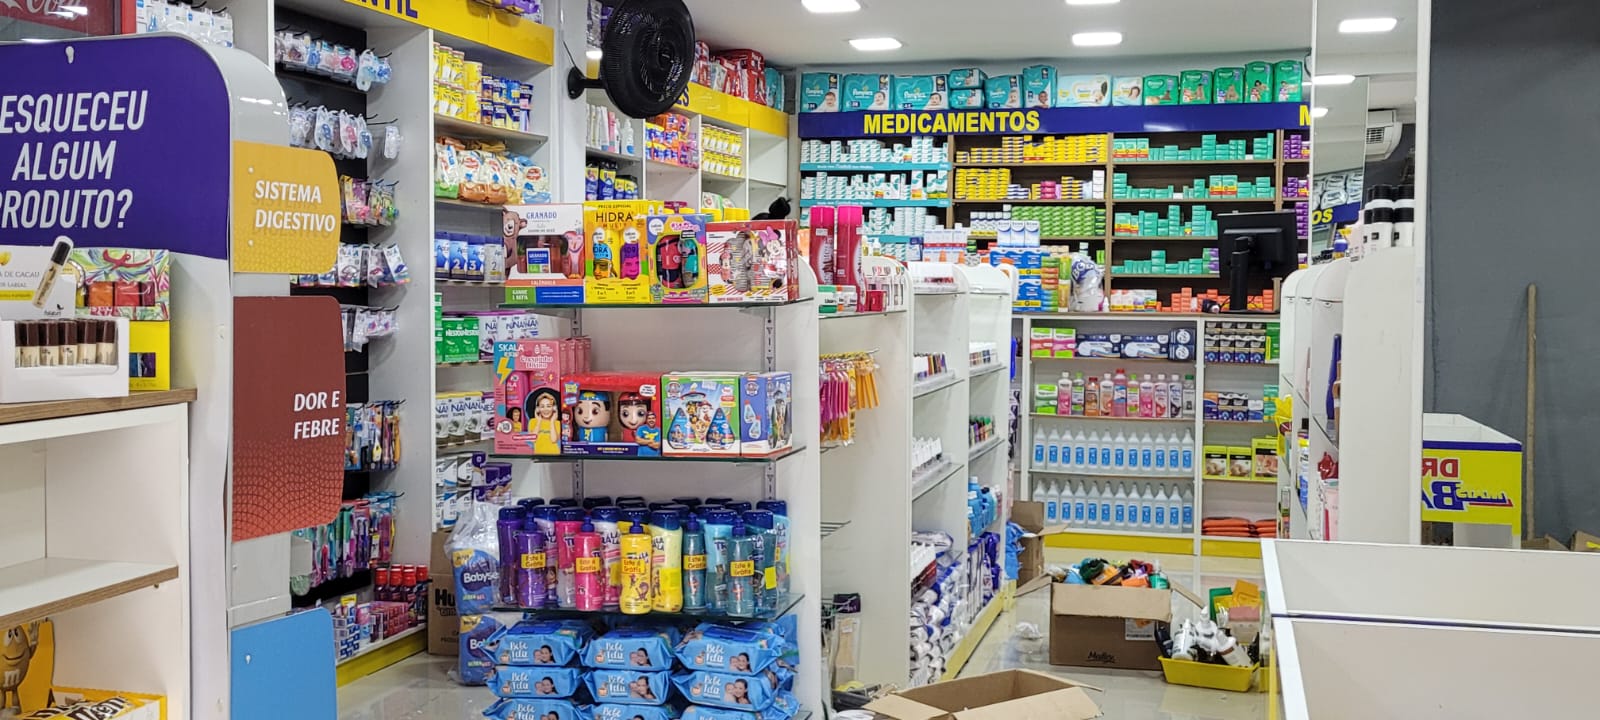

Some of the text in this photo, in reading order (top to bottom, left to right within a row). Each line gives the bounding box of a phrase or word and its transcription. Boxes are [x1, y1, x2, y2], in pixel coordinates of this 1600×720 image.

[0, 90, 149, 134] ESQUECEU
[863, 110, 1040, 134] MEDICAMENTOS
[11, 140, 117, 181] ALGUM
[254, 180, 322, 203] SISTEMA
[254, 209, 337, 232] DIGESTIVO
[526, 211, 558, 220] GRANADO
[595, 211, 634, 222] HIDRA
[498, 343, 525, 353] SKALA
[293, 390, 341, 412] DOR E
[293, 418, 341, 440] FEBRE
[434, 588, 456, 607] Hu
